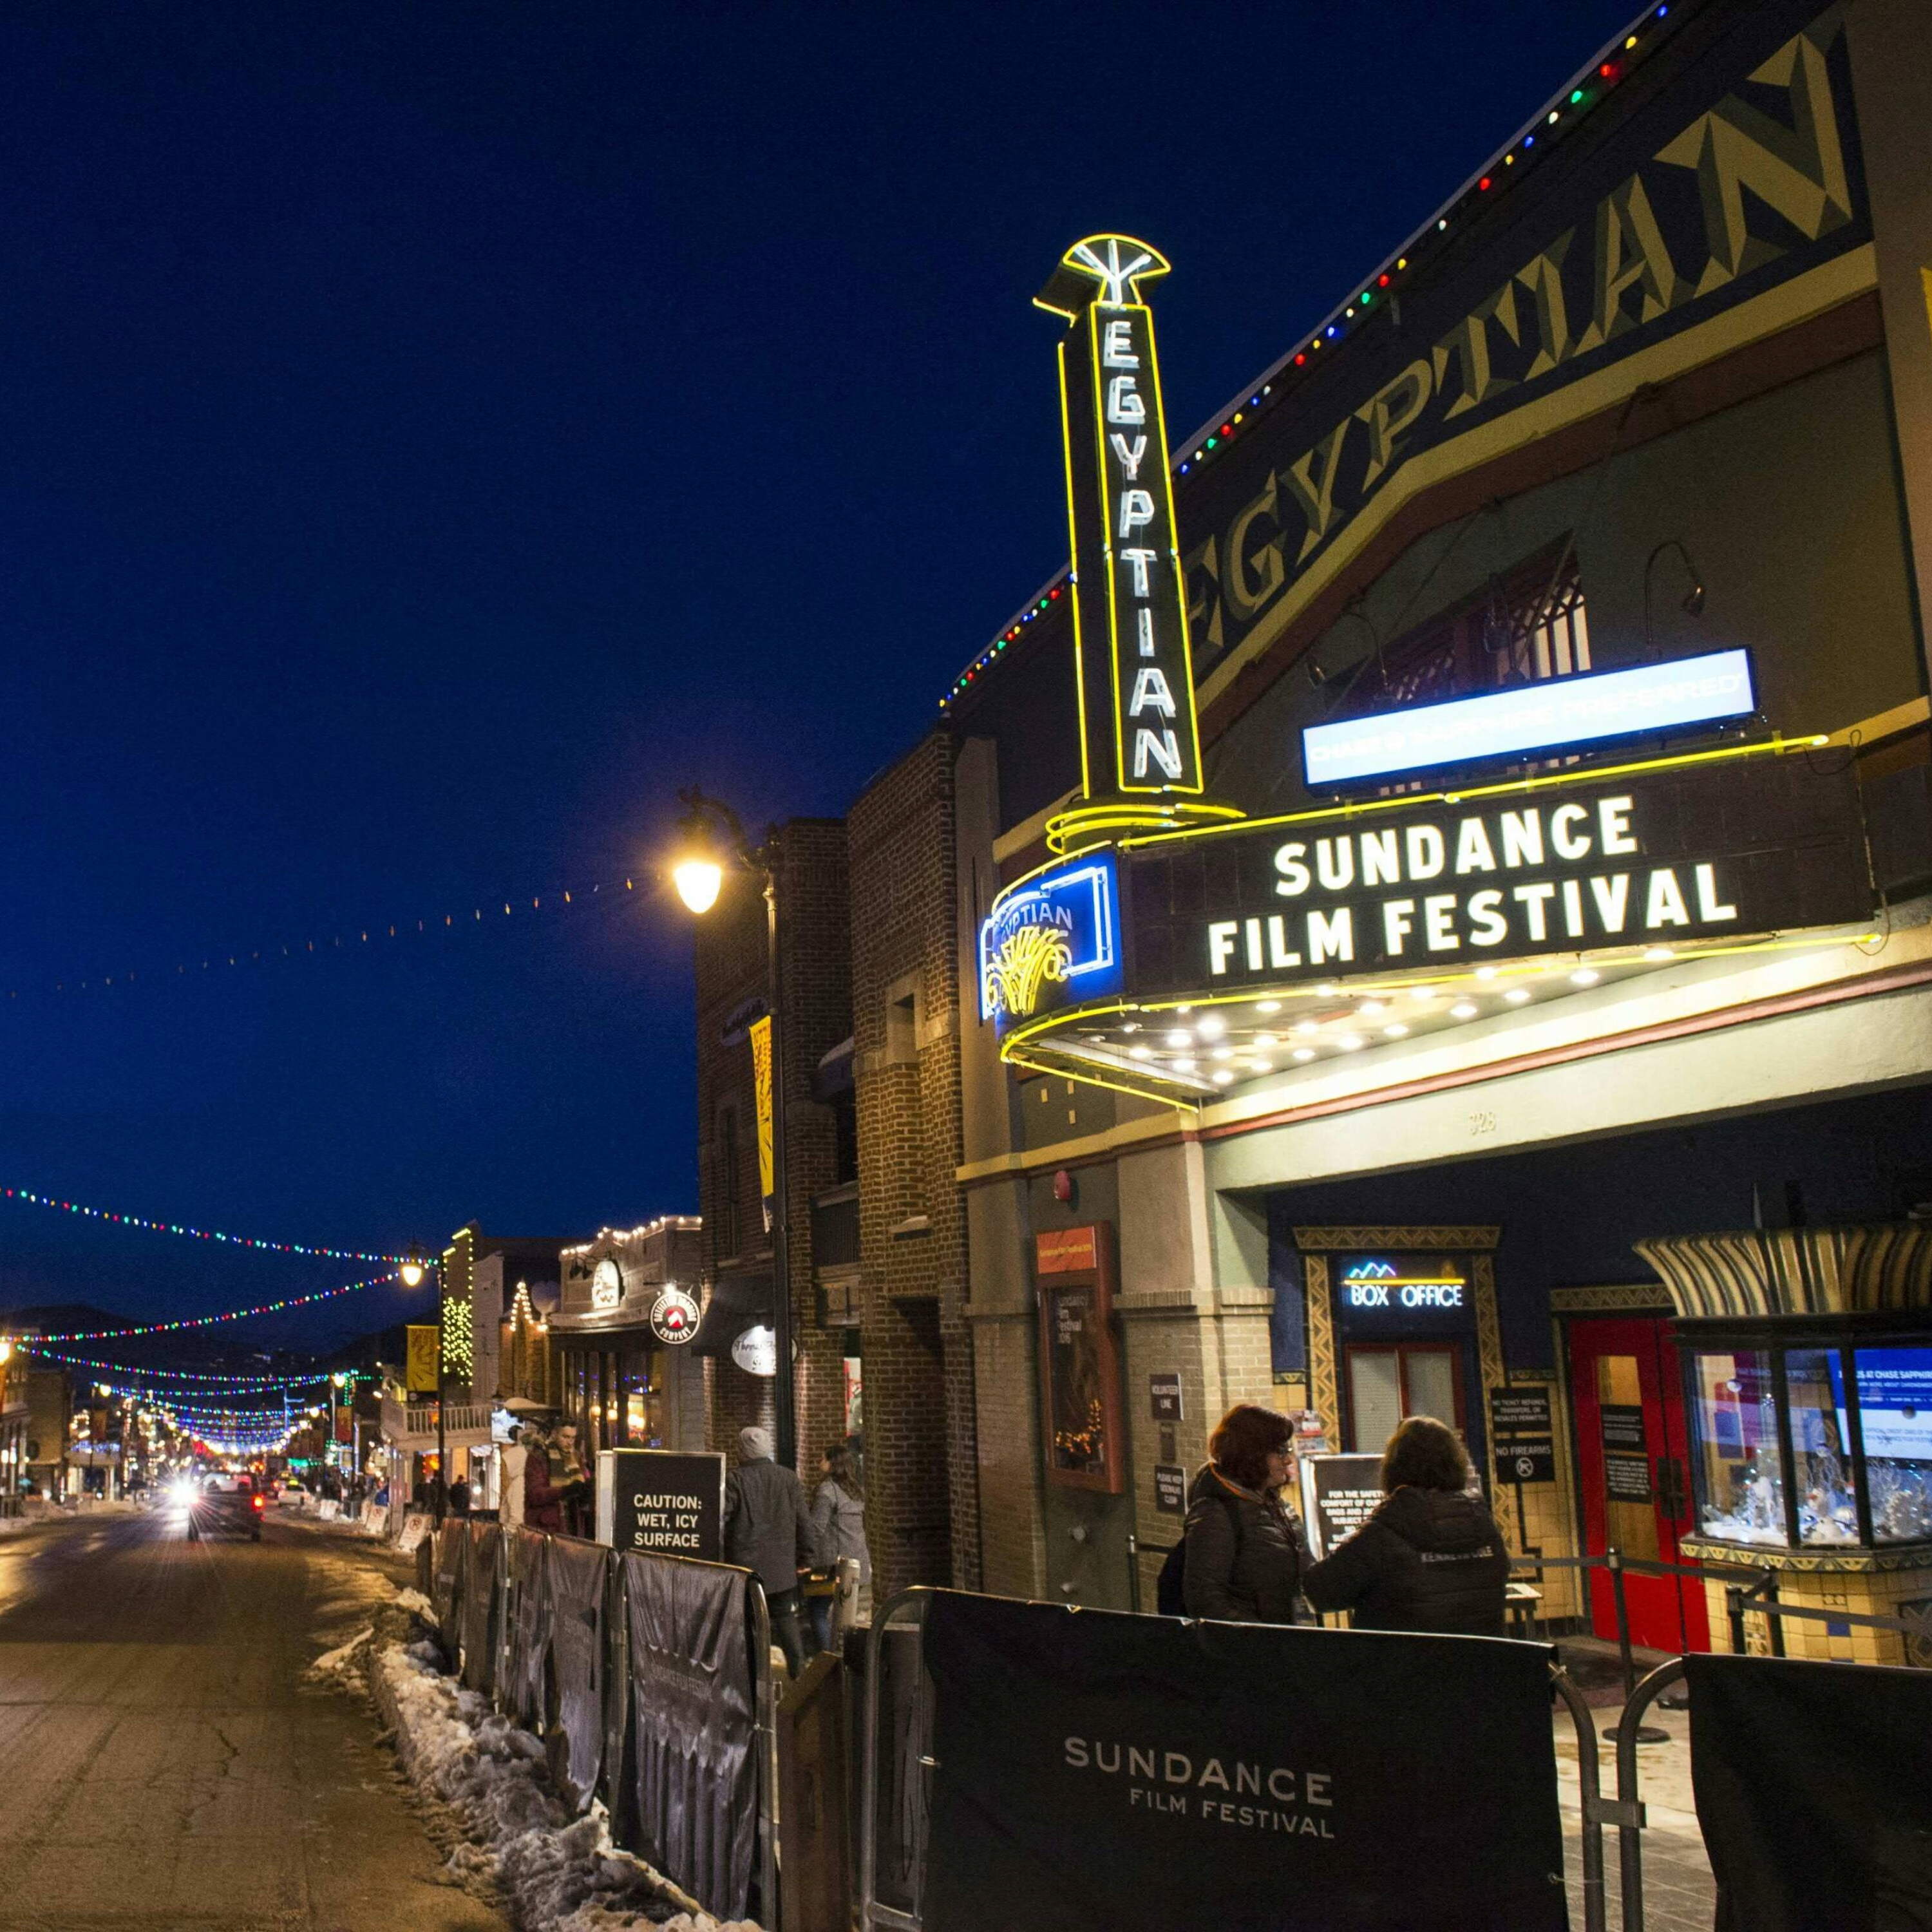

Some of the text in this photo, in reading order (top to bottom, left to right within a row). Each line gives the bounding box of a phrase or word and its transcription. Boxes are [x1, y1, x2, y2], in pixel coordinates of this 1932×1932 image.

[1184, 21, 1853, 648] EGYPTIAN
[1103, 321, 1182, 779] EGYPTIAN
[1274, 795, 1638, 896] SUNDANCE
[1002, 902, 1073, 939] YPTIAN
[1208, 863, 1738, 975] FILM FESTIVAL
[1350, 1285, 1463, 1307] BOX OFFICE
[659, 1326, 692, 1341] COMPANY
[1875, 1370, 1900, 1379] CHASE
[1495, 1445, 1551, 1457] NO FIREARMS
[634, 1493, 702, 1510] CAUTION:
[1328, 1490, 1343, 1499] FOR
[1344, 1490, 1359, 1499] THE
[1320, 1499, 1354, 1508] COMFORT
[1326, 1508, 1346, 1516] BAGS
[1347, 1508, 1362, 1516] AND
[637, 1513, 699, 1530] WET, ICY
[1331, 1516, 1362, 1525] SUBJECT
[634, 1531, 701, 1548] SURFACE
[1064, 1737, 1333, 1807] SUNDANCE
[1130, 1788, 1334, 1839] FILM FESTIVAL
